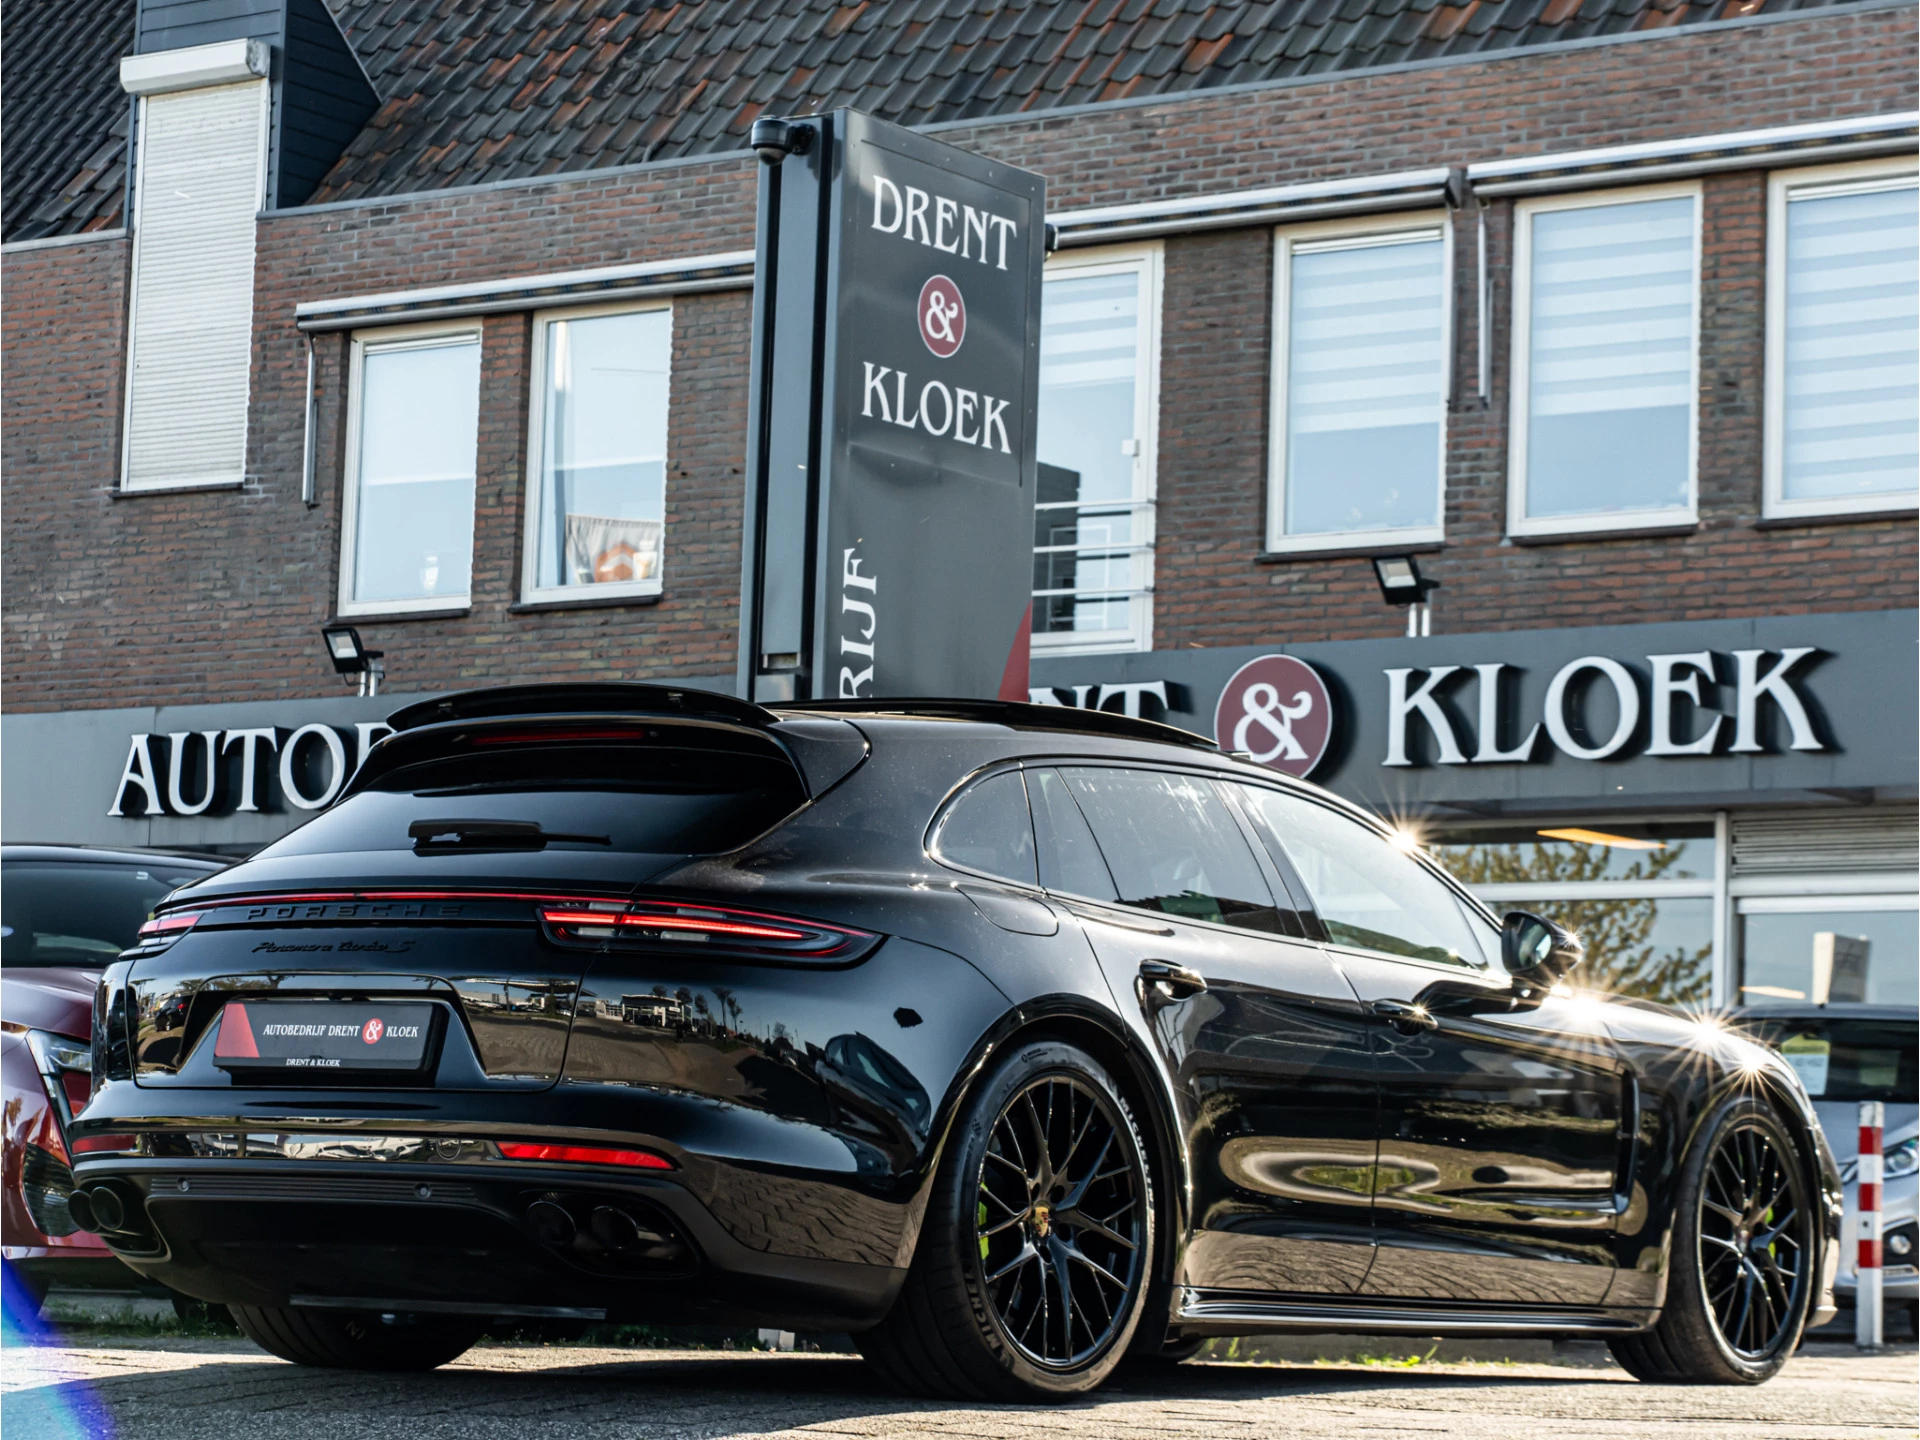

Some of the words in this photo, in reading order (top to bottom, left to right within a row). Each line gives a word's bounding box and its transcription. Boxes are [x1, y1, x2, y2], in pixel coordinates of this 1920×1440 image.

[871, 175, 1017, 271] DRENT
[924, 289, 959, 343] &
[861, 361, 1012, 455] KLOEK
[1232, 681, 1312, 763] &
[1381, 646, 1825, 767] KLOEK
[247, 903, 466, 920] PORSCHE
[263, 1023, 327, 1037] AUTOBEDRIJF
[328, 1025, 360, 1037] DRENT
[365, 1018, 382, 1041] &
[386, 1026, 419, 1038] KLOEK
[286, 1058, 310, 1066] DRENT
[316, 1059, 341, 1067] KLOEK
